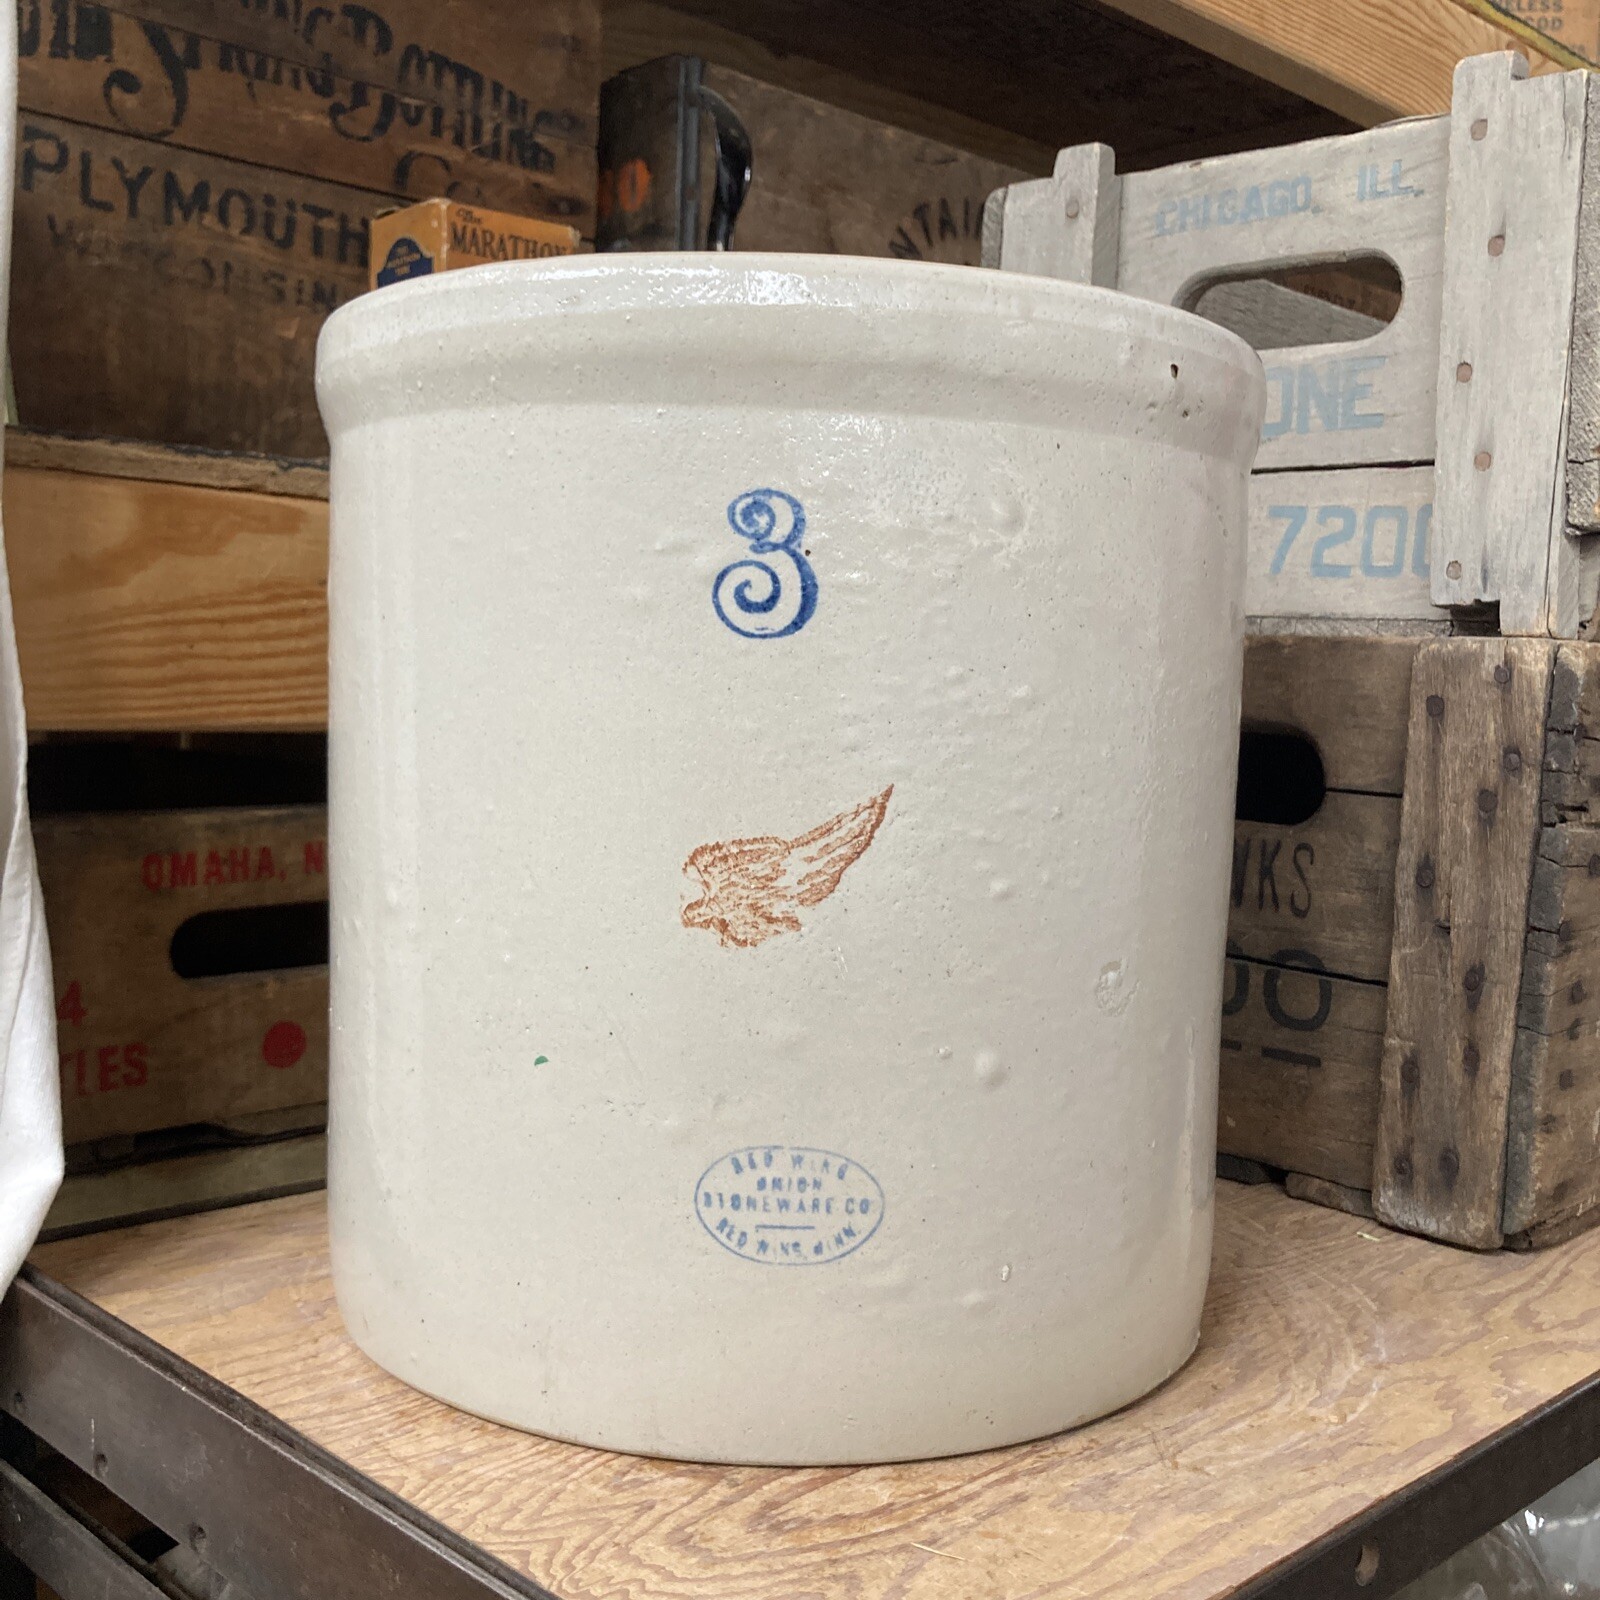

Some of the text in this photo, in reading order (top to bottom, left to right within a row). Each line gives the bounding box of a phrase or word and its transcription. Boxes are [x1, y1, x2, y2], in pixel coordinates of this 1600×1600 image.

[22, 126, 370, 268] PLYMOUTH
[452, 222, 567, 261] MARATHO
[712, 488, 819, 638] 3
[141, 846, 287, 892] OMAHA,
